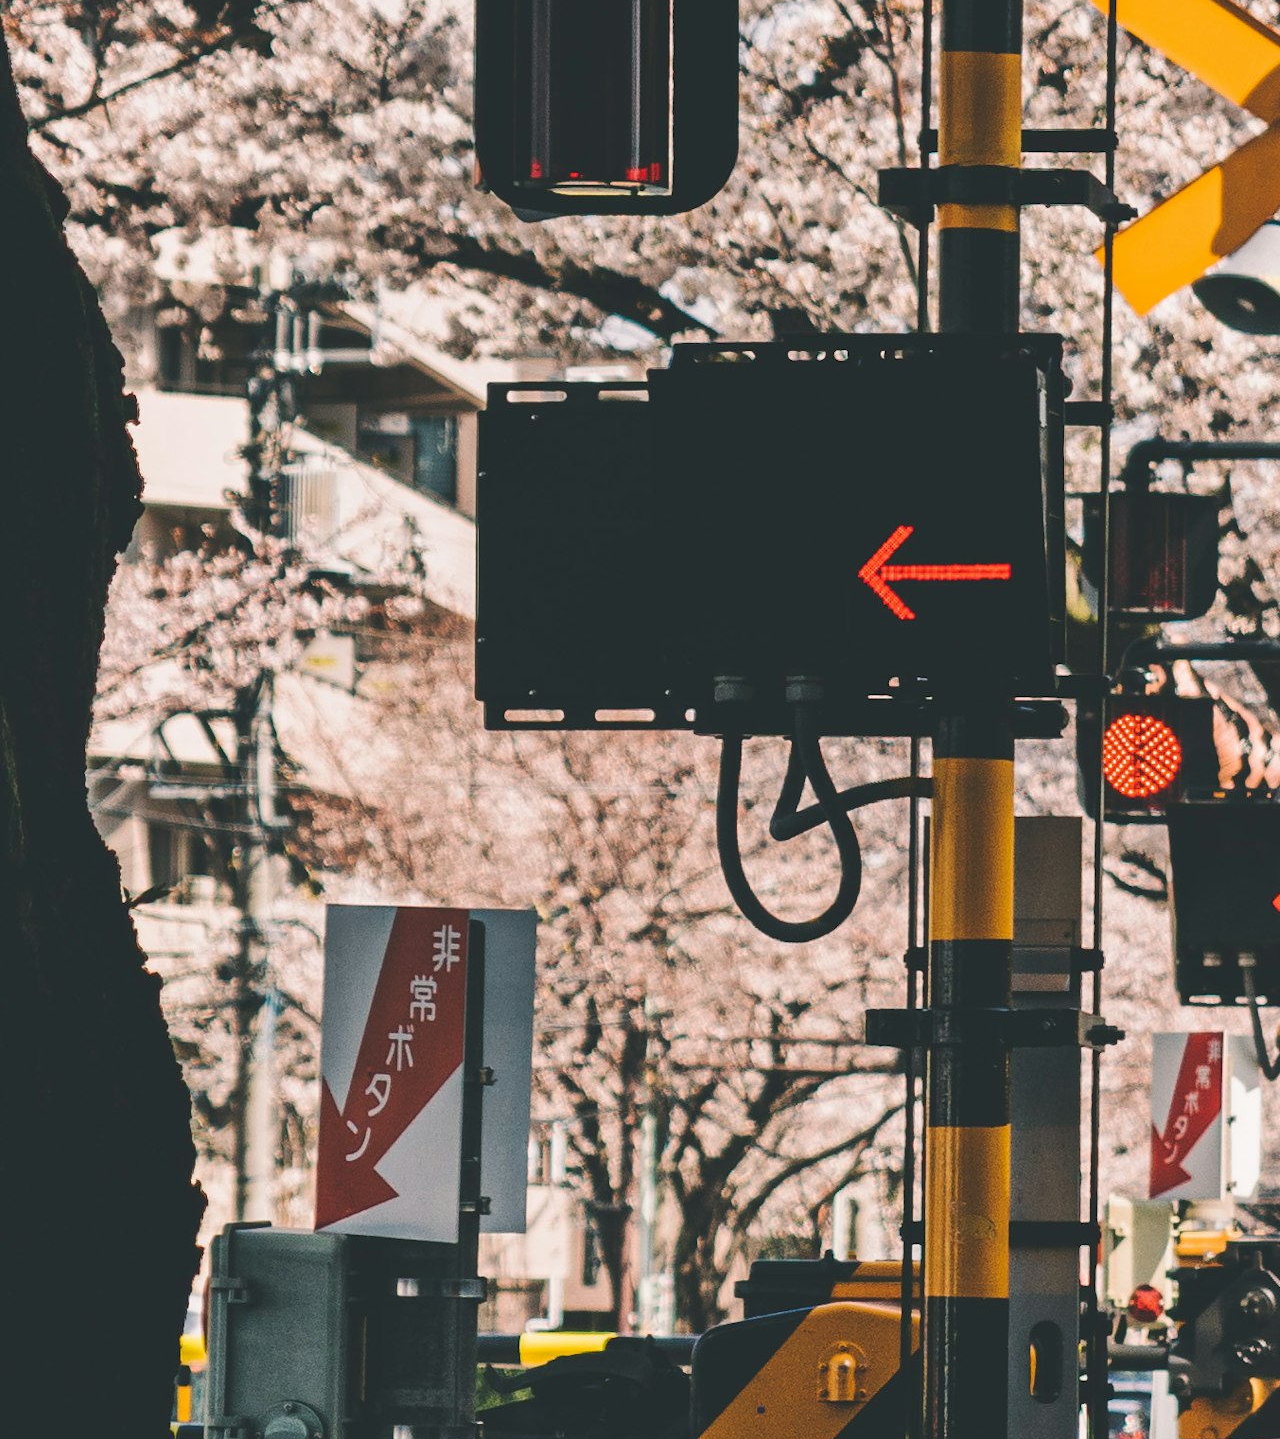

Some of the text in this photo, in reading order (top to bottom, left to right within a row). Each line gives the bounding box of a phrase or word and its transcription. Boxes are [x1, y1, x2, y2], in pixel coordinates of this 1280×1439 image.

[345, 924, 462, 1162] 非常ボタン
